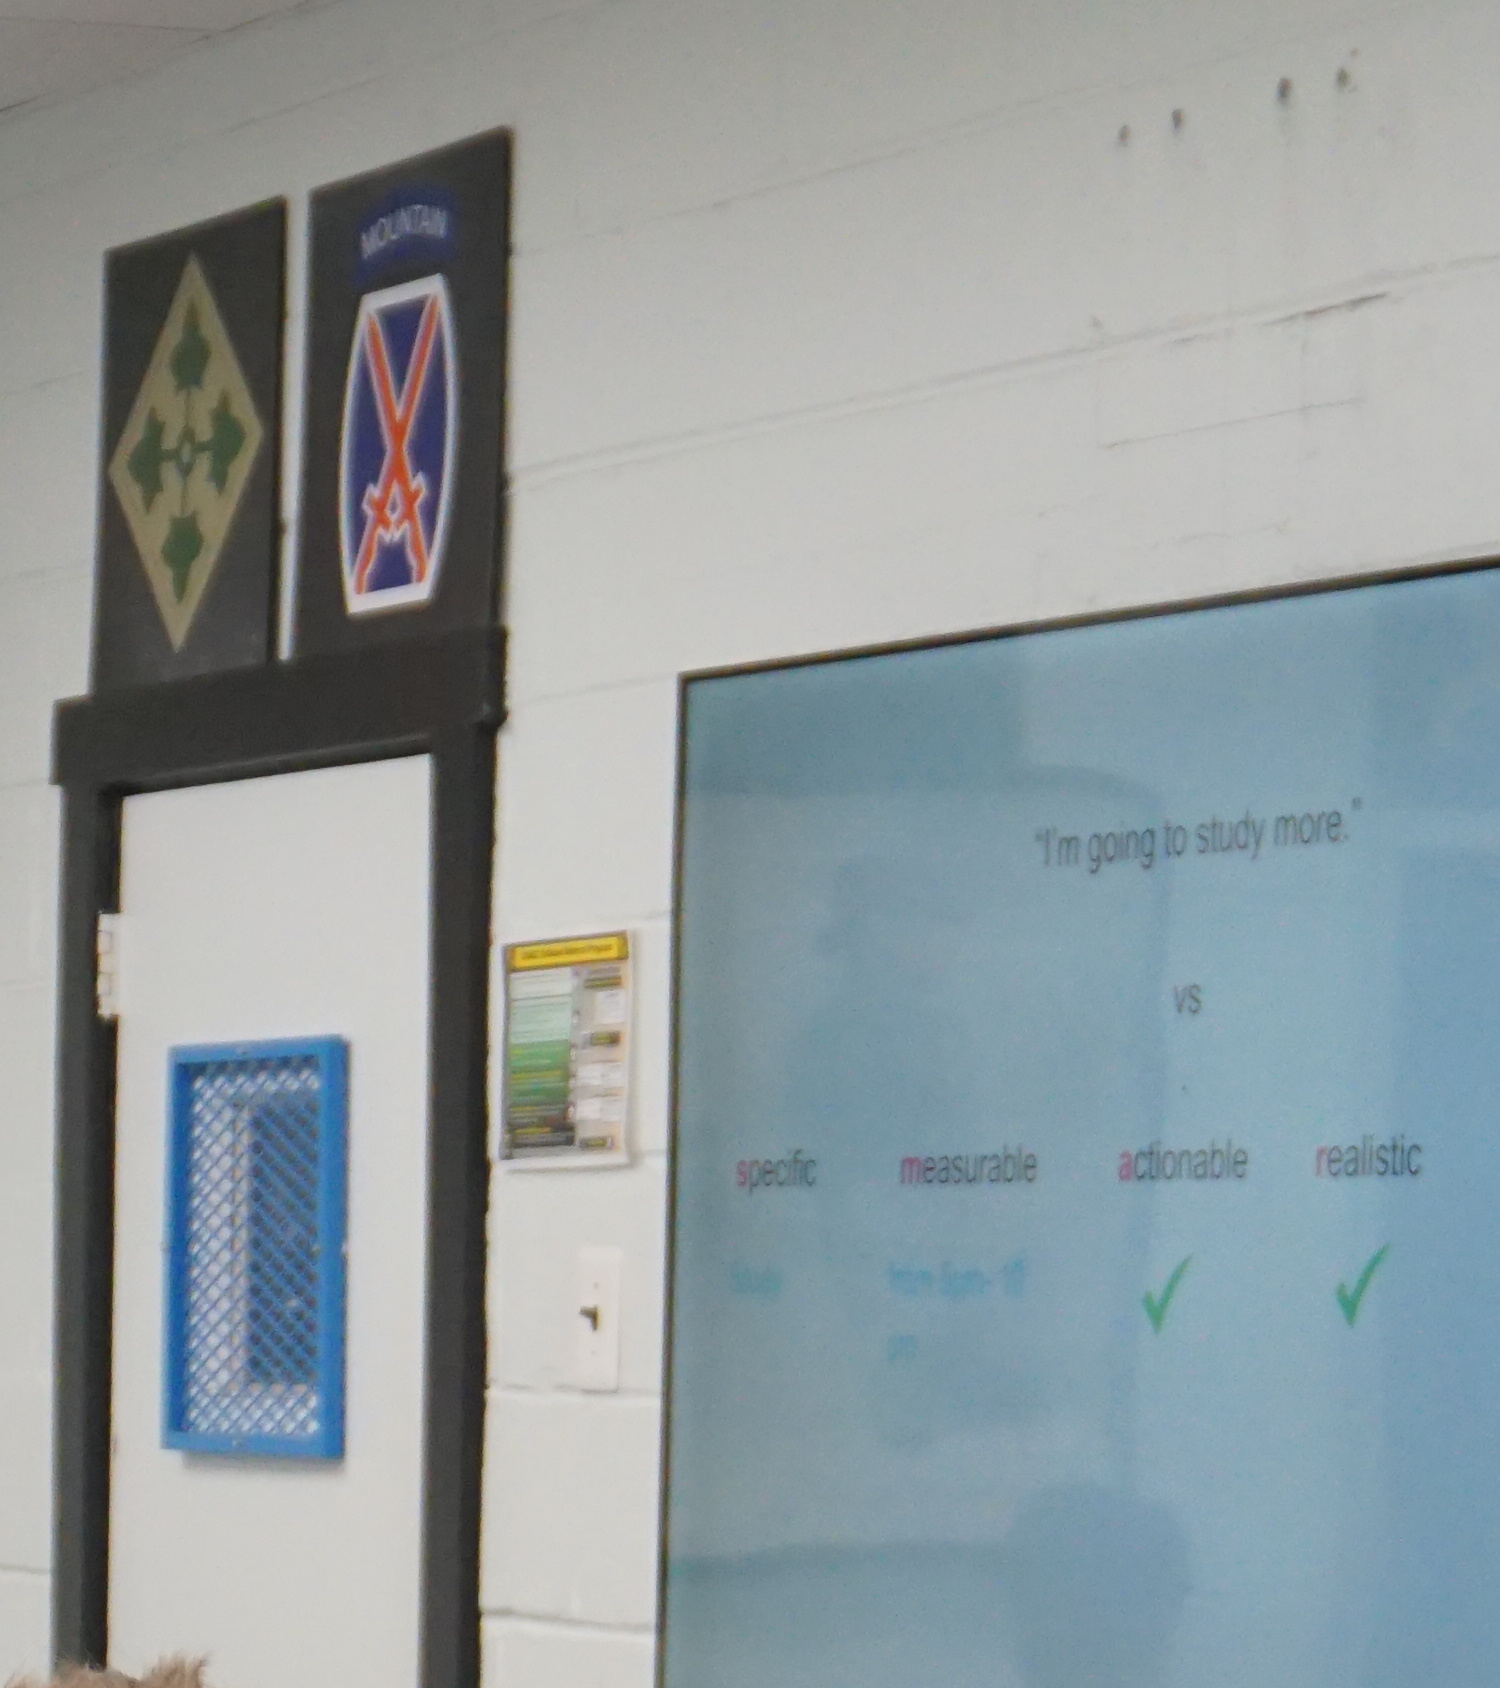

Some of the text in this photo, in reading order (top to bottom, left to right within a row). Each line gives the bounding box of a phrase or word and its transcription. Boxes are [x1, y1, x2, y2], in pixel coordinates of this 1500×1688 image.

[361, 204, 447, 260] MOUNTAIN
[1088, 826, 1157, 874] going
[1162, 818, 1188, 858] to
[1195, 808, 1266, 862] study
[1174, 983, 1202, 1015] vs
[736, 1149, 817, 1193] specific
[900, 1143, 1038, 1185] measurable
[1118, 1139, 1249, 1182] actionable
[1314, 1133, 1422, 1177] realistic
